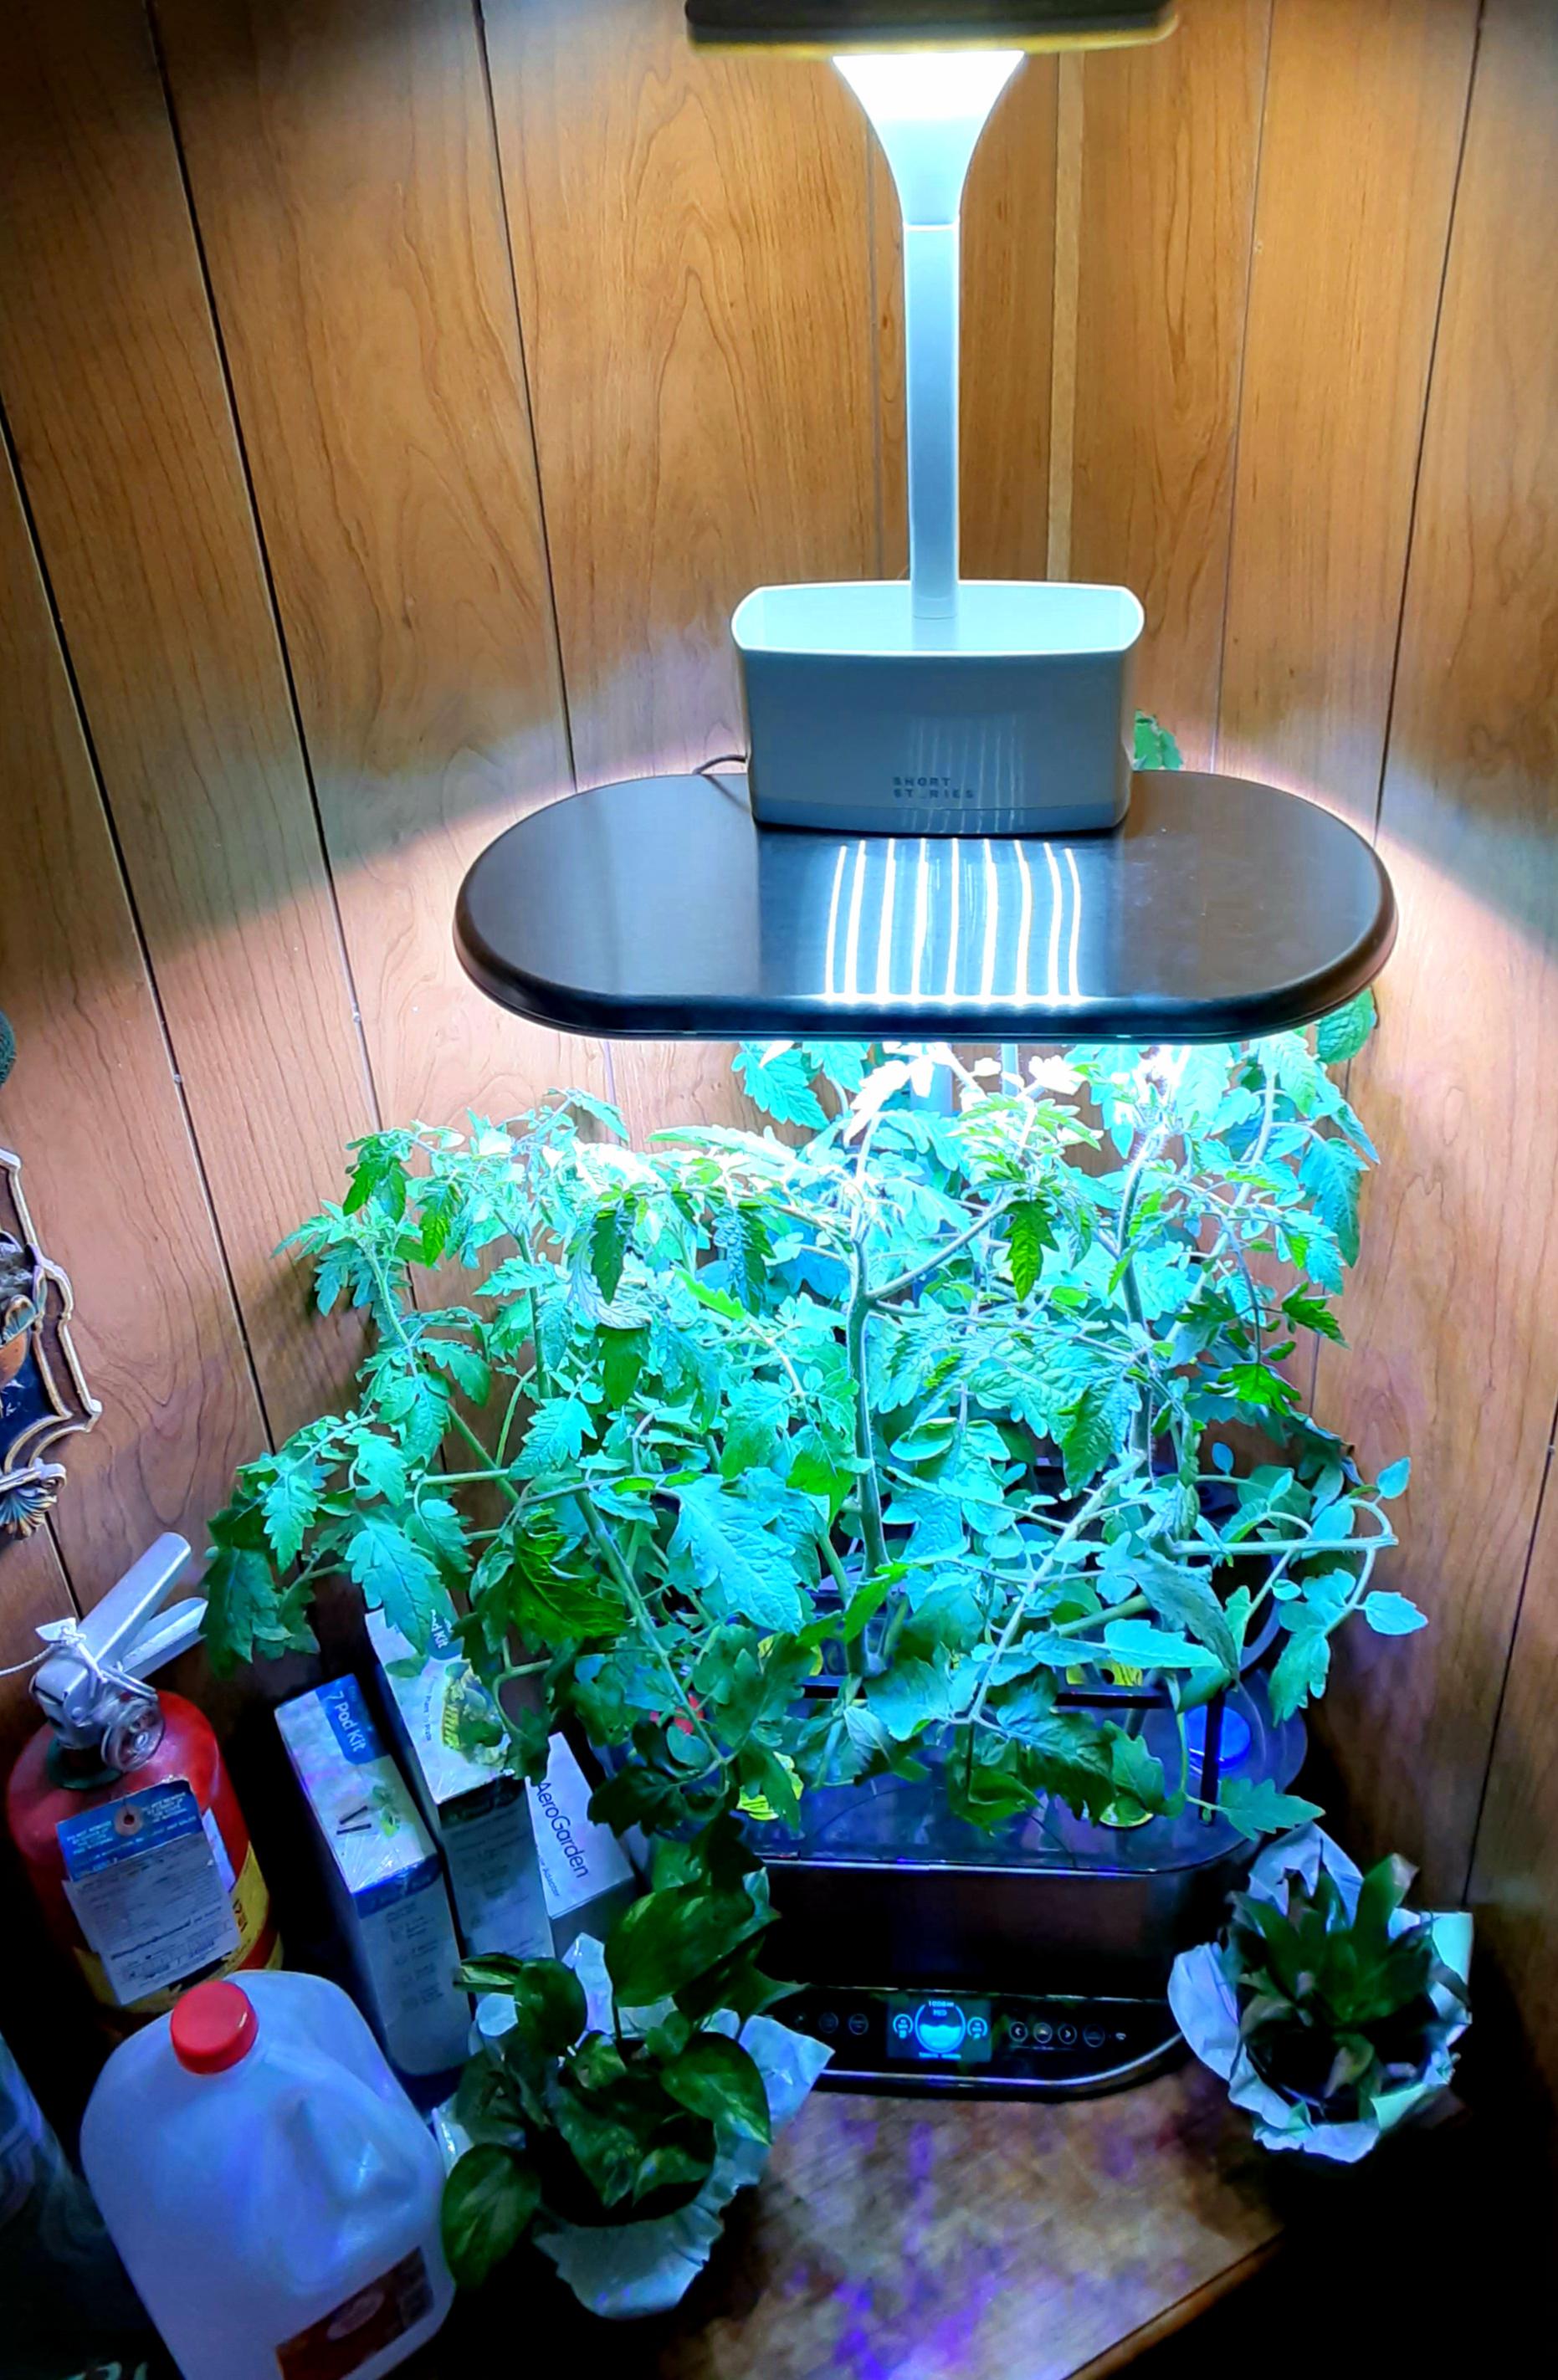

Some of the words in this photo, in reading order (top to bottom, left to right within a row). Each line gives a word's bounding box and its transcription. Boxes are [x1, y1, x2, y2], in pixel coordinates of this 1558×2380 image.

[892, 776, 951, 786] SHORT
[433, 1630, 449, 1649] Kit
[325, 1690, 345, 1701] 7
[335, 1701, 359, 1731] Pod
[346, 1728, 366, 1753] Kit
[536, 1782, 589, 1878] AeroGarden
